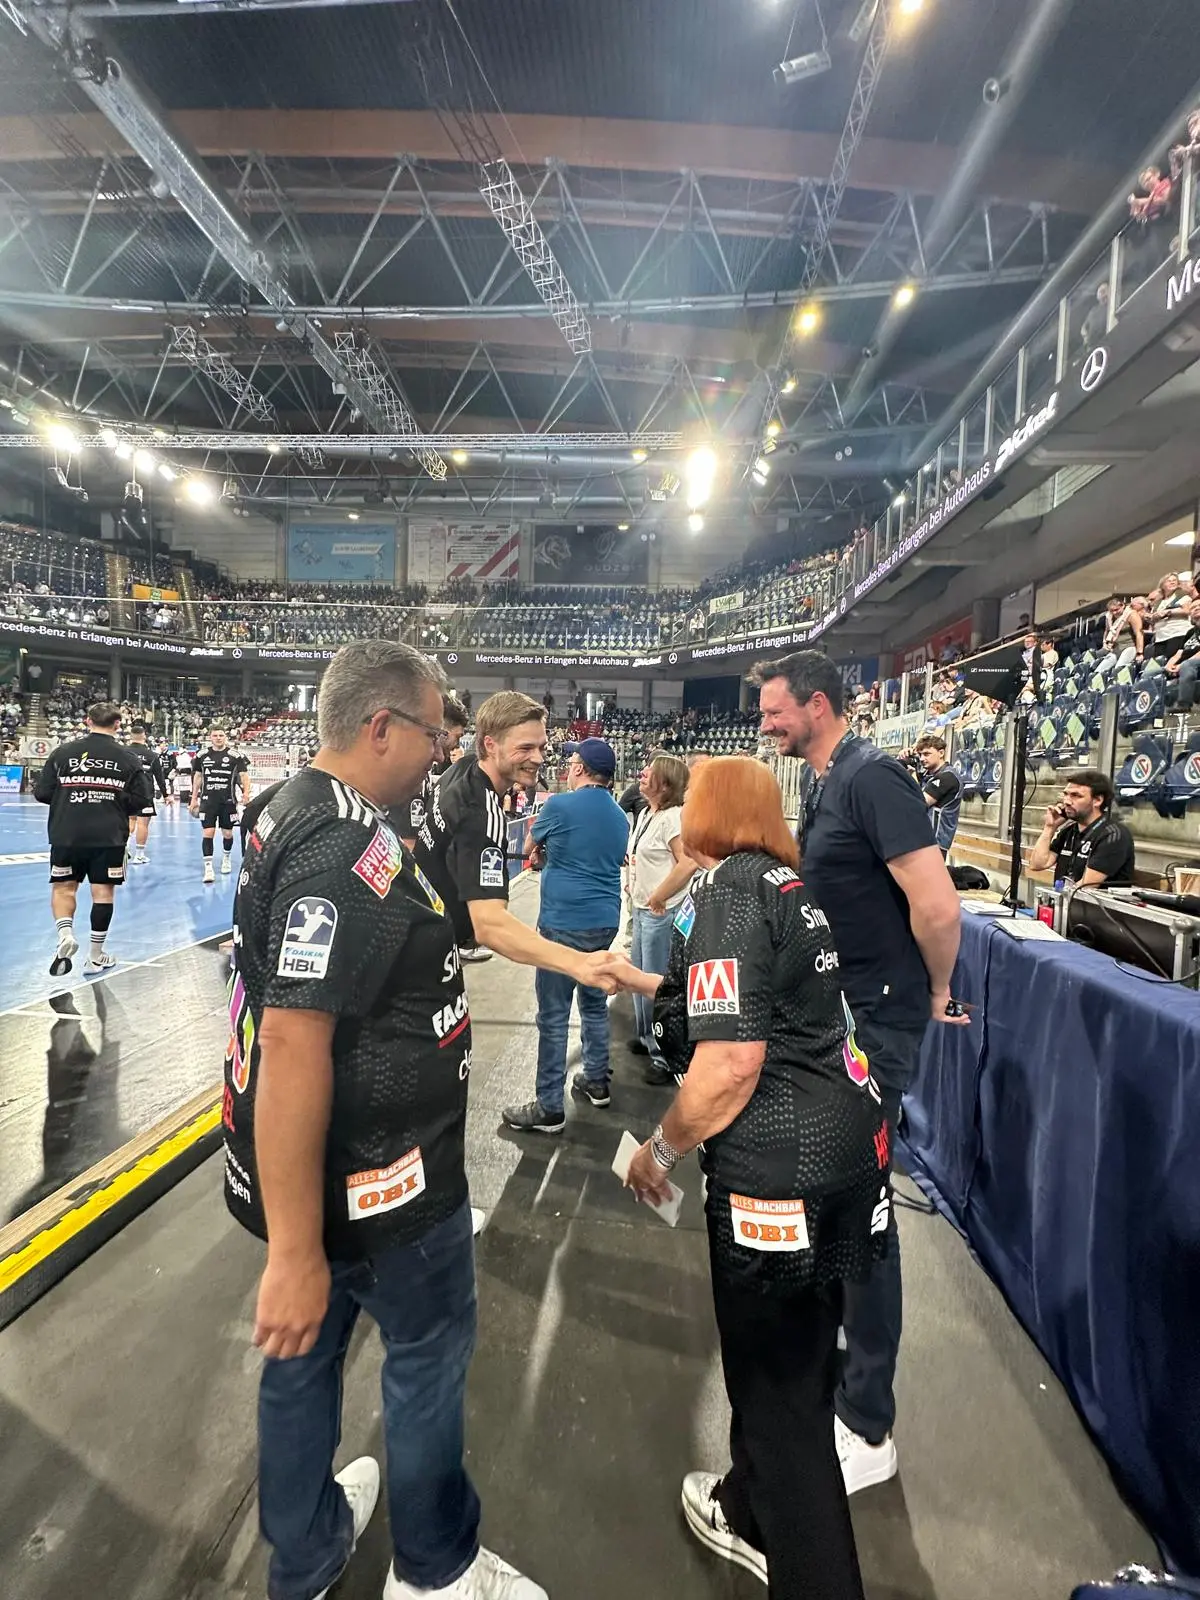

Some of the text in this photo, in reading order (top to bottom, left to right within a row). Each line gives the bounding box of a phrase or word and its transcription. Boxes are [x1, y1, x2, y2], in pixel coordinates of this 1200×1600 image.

[899, 520, 928, 558] Erlangen
[929, 505, 942, 529] bei
[943, 461, 990, 517] Autohaus
[68, 630, 78, 639] in
[80, 631, 124, 646] Erlangen
[127, 637, 141, 648] bei
[143, 640, 186, 654] Autohaus
[692, 643, 745, 659] Mercedes-Benz
[746, 642, 754, 651] in
[755, 633, 791, 649] Erlangen
[792, 631, 806, 643] bei
[258, 648, 312, 659] Mercedes-Benz
[314, 650, 321, 659] in
[475, 654, 533, 664] Mercedes-Benz
[535, 655, 542, 664] in
[544, 656, 577, 666] Erlangen
[579, 656, 591, 666] bei
[593, 657, 629, 666] Autohaus
[292, 949, 324, 958] DAIKIN
[283, 957, 321, 973] HBL
[692, 1001, 737, 1014] MAUSS
[349, 1172, 377, 1187] ALLES
[358, 1172, 418, 1210] OBI
[754, 1200, 801, 1213] MACHBAR
[740, 1220, 799, 1241] OBI
